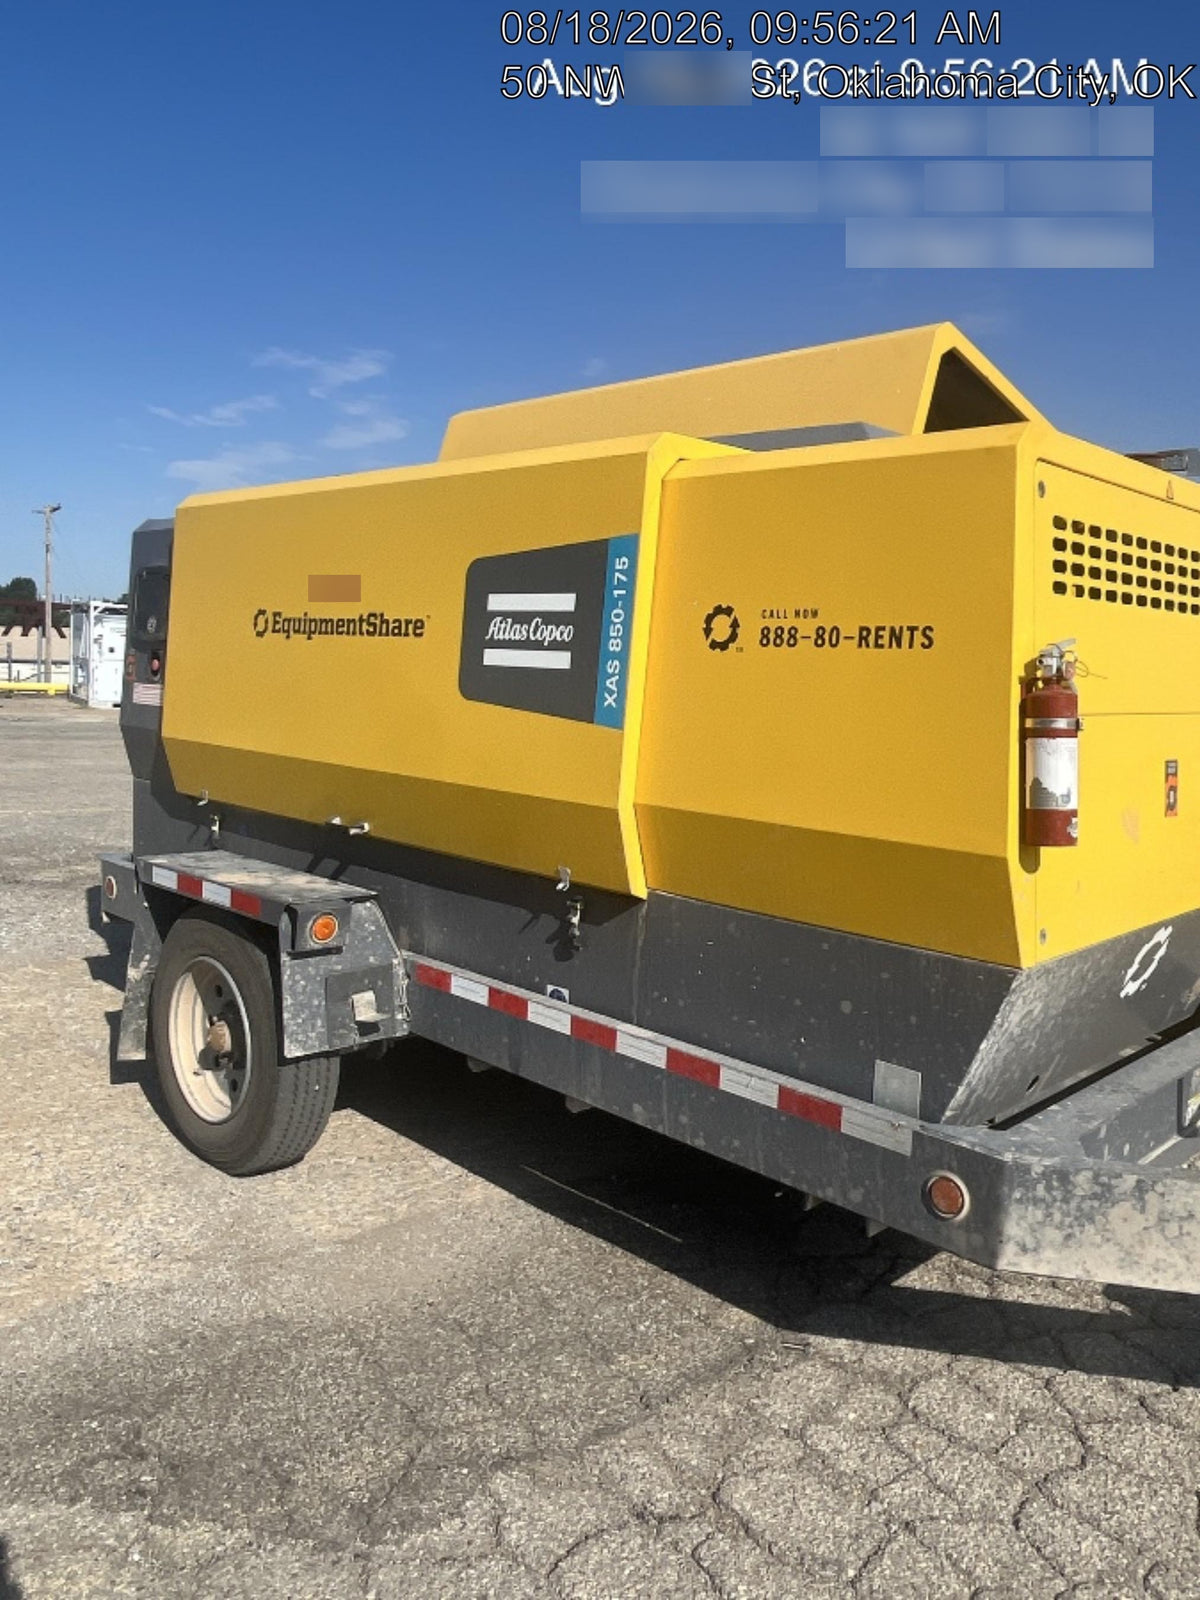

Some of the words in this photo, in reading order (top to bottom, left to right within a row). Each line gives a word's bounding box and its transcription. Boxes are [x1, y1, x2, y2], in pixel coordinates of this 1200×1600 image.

[608, 555, 629, 652] 850-175
[760, 608, 789, 620] CALL
[794, 607, 819, 620] NOW
[271, 611, 426, 640] EquipmentShare
[485, 616, 529, 641] Atlas
[529, 616, 574, 646] Copco
[758, 625, 935, 650] 888-80-RENTS
[603, 659, 620, 708] XAS
